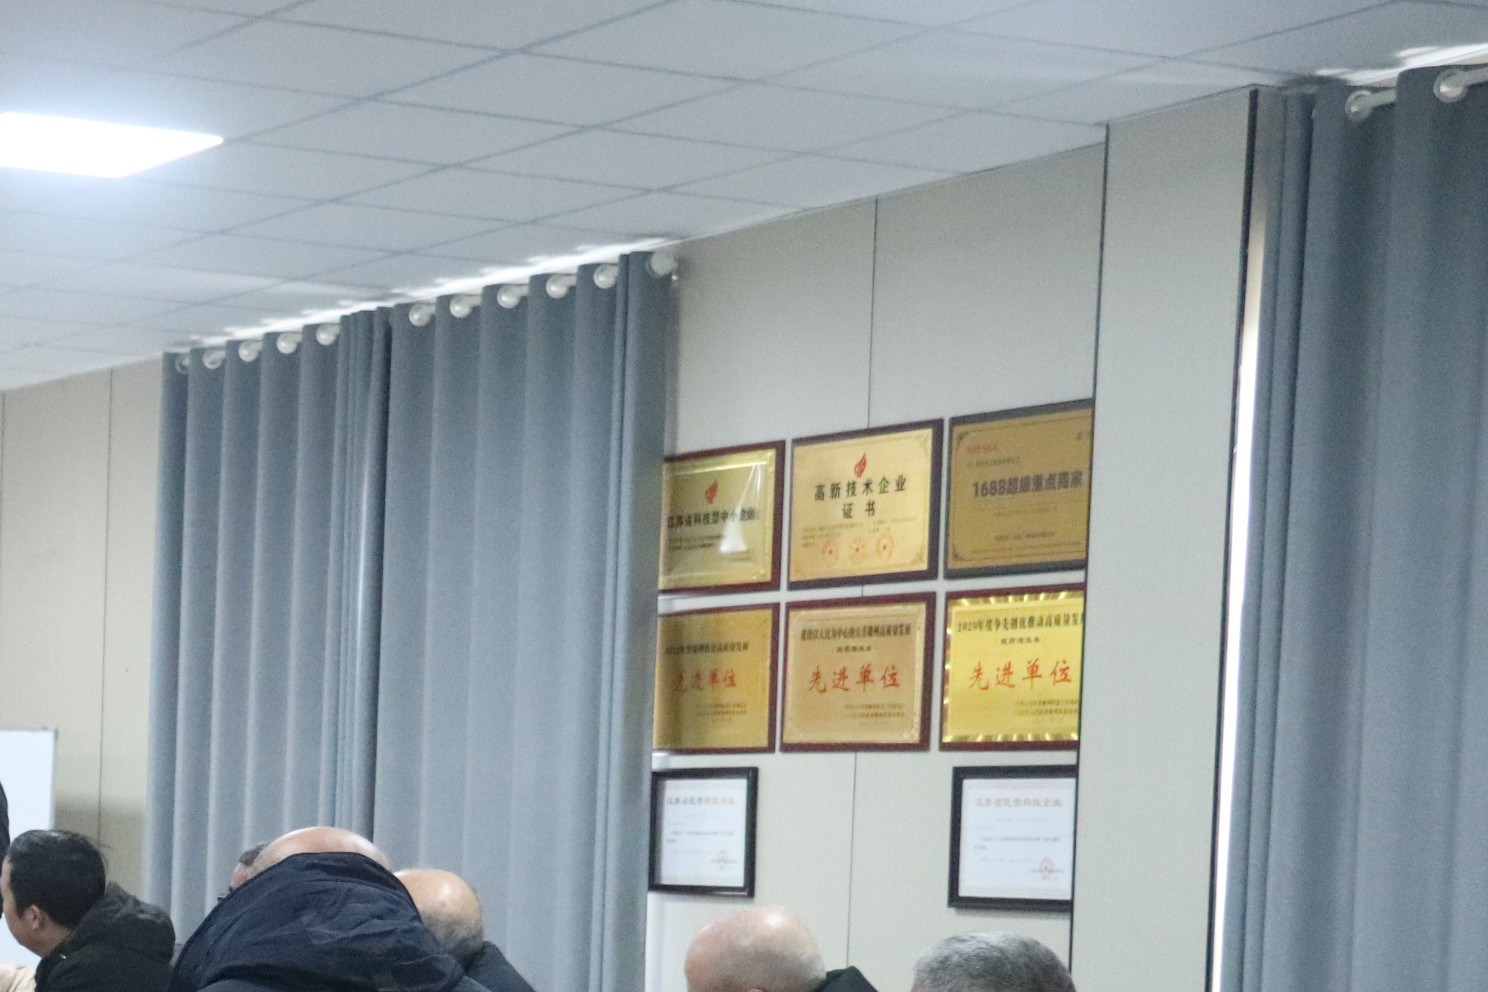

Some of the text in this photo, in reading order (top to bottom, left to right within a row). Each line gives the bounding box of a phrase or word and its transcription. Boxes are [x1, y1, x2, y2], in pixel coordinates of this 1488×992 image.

[814, 474, 907, 501] 高新技术企业
[842, 499, 876, 520] 证书
[807, 663, 900, 694] 先进单位
[968, 658, 1072, 691] 先进单位
